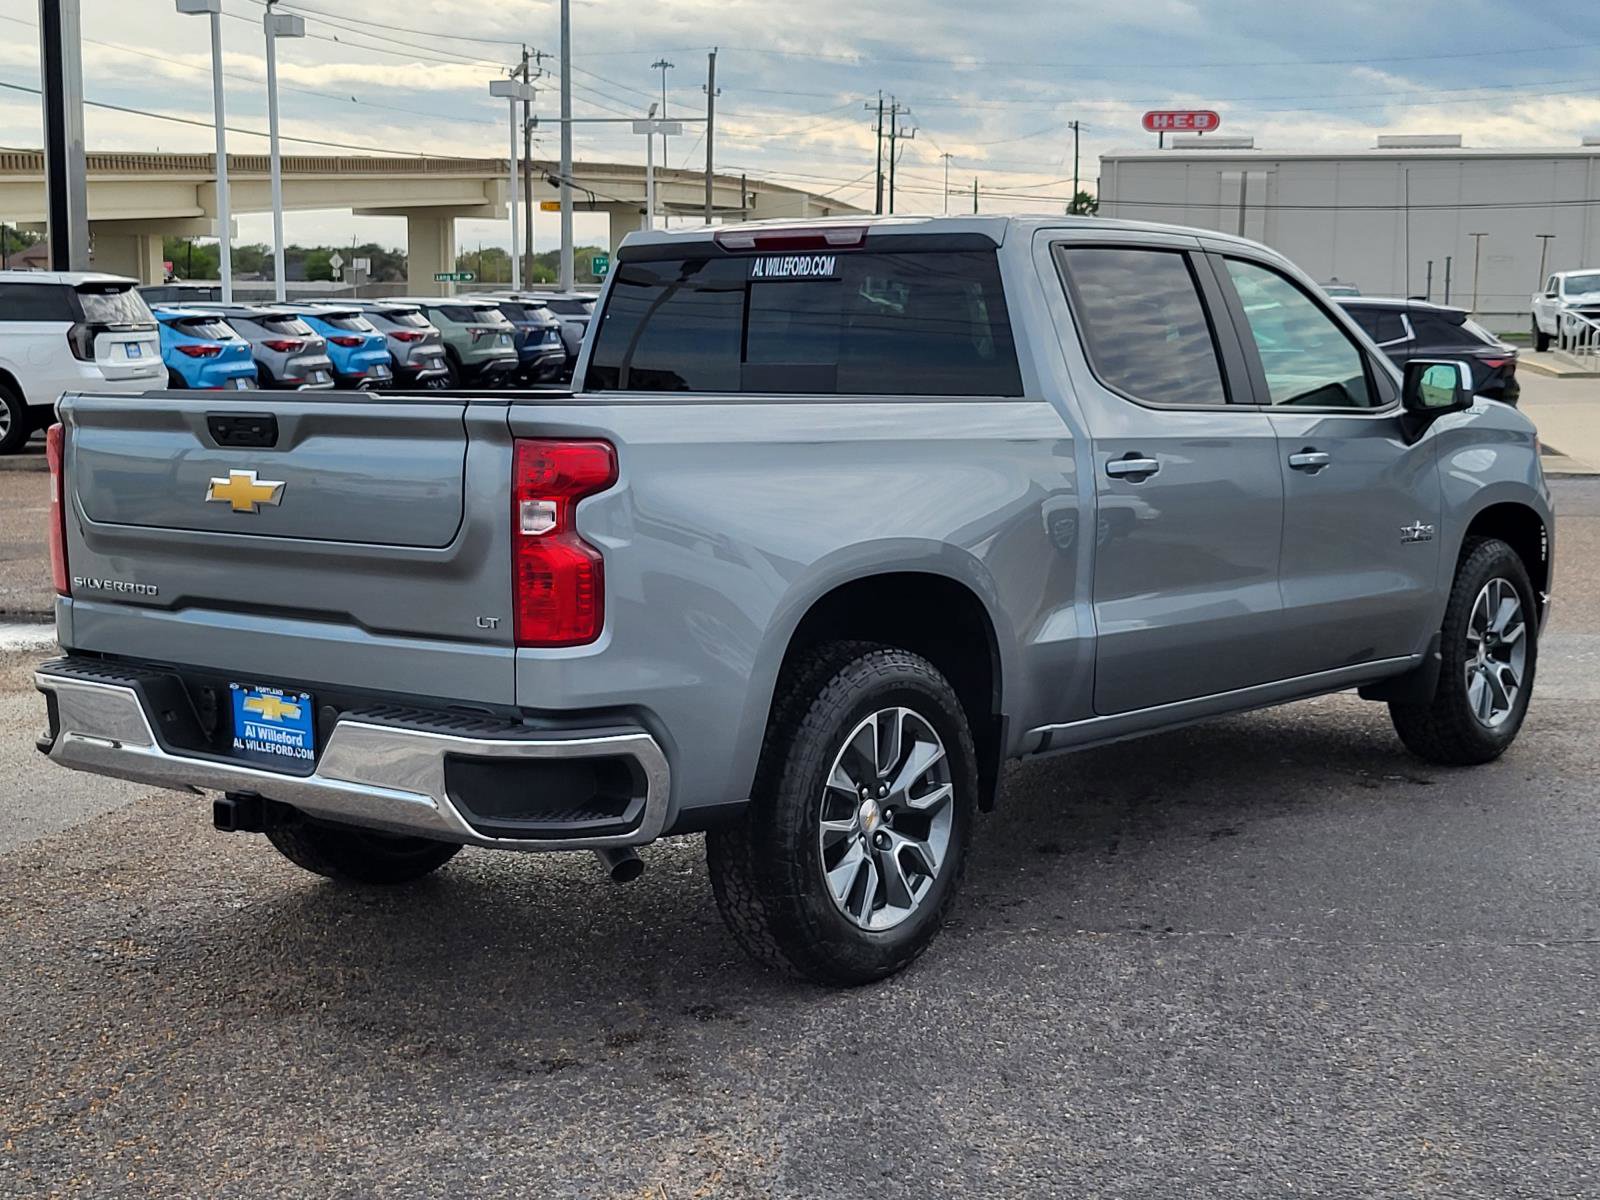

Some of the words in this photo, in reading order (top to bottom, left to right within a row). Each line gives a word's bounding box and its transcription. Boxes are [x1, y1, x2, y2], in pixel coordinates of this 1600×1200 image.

[752, 257, 764, 276] AL
[765, 256, 836, 276] WILLEFORD.COM
[74, 576, 157, 595] SILVERADO
[476, 616, 499, 629] LT
[255, 686, 284, 696] PORTLAND
[245, 724, 256, 738] Al
[257, 727, 303, 747] Willeford
[233, 737, 245, 749] AL
[245, 739, 315, 760] WILLEFORD.COM
